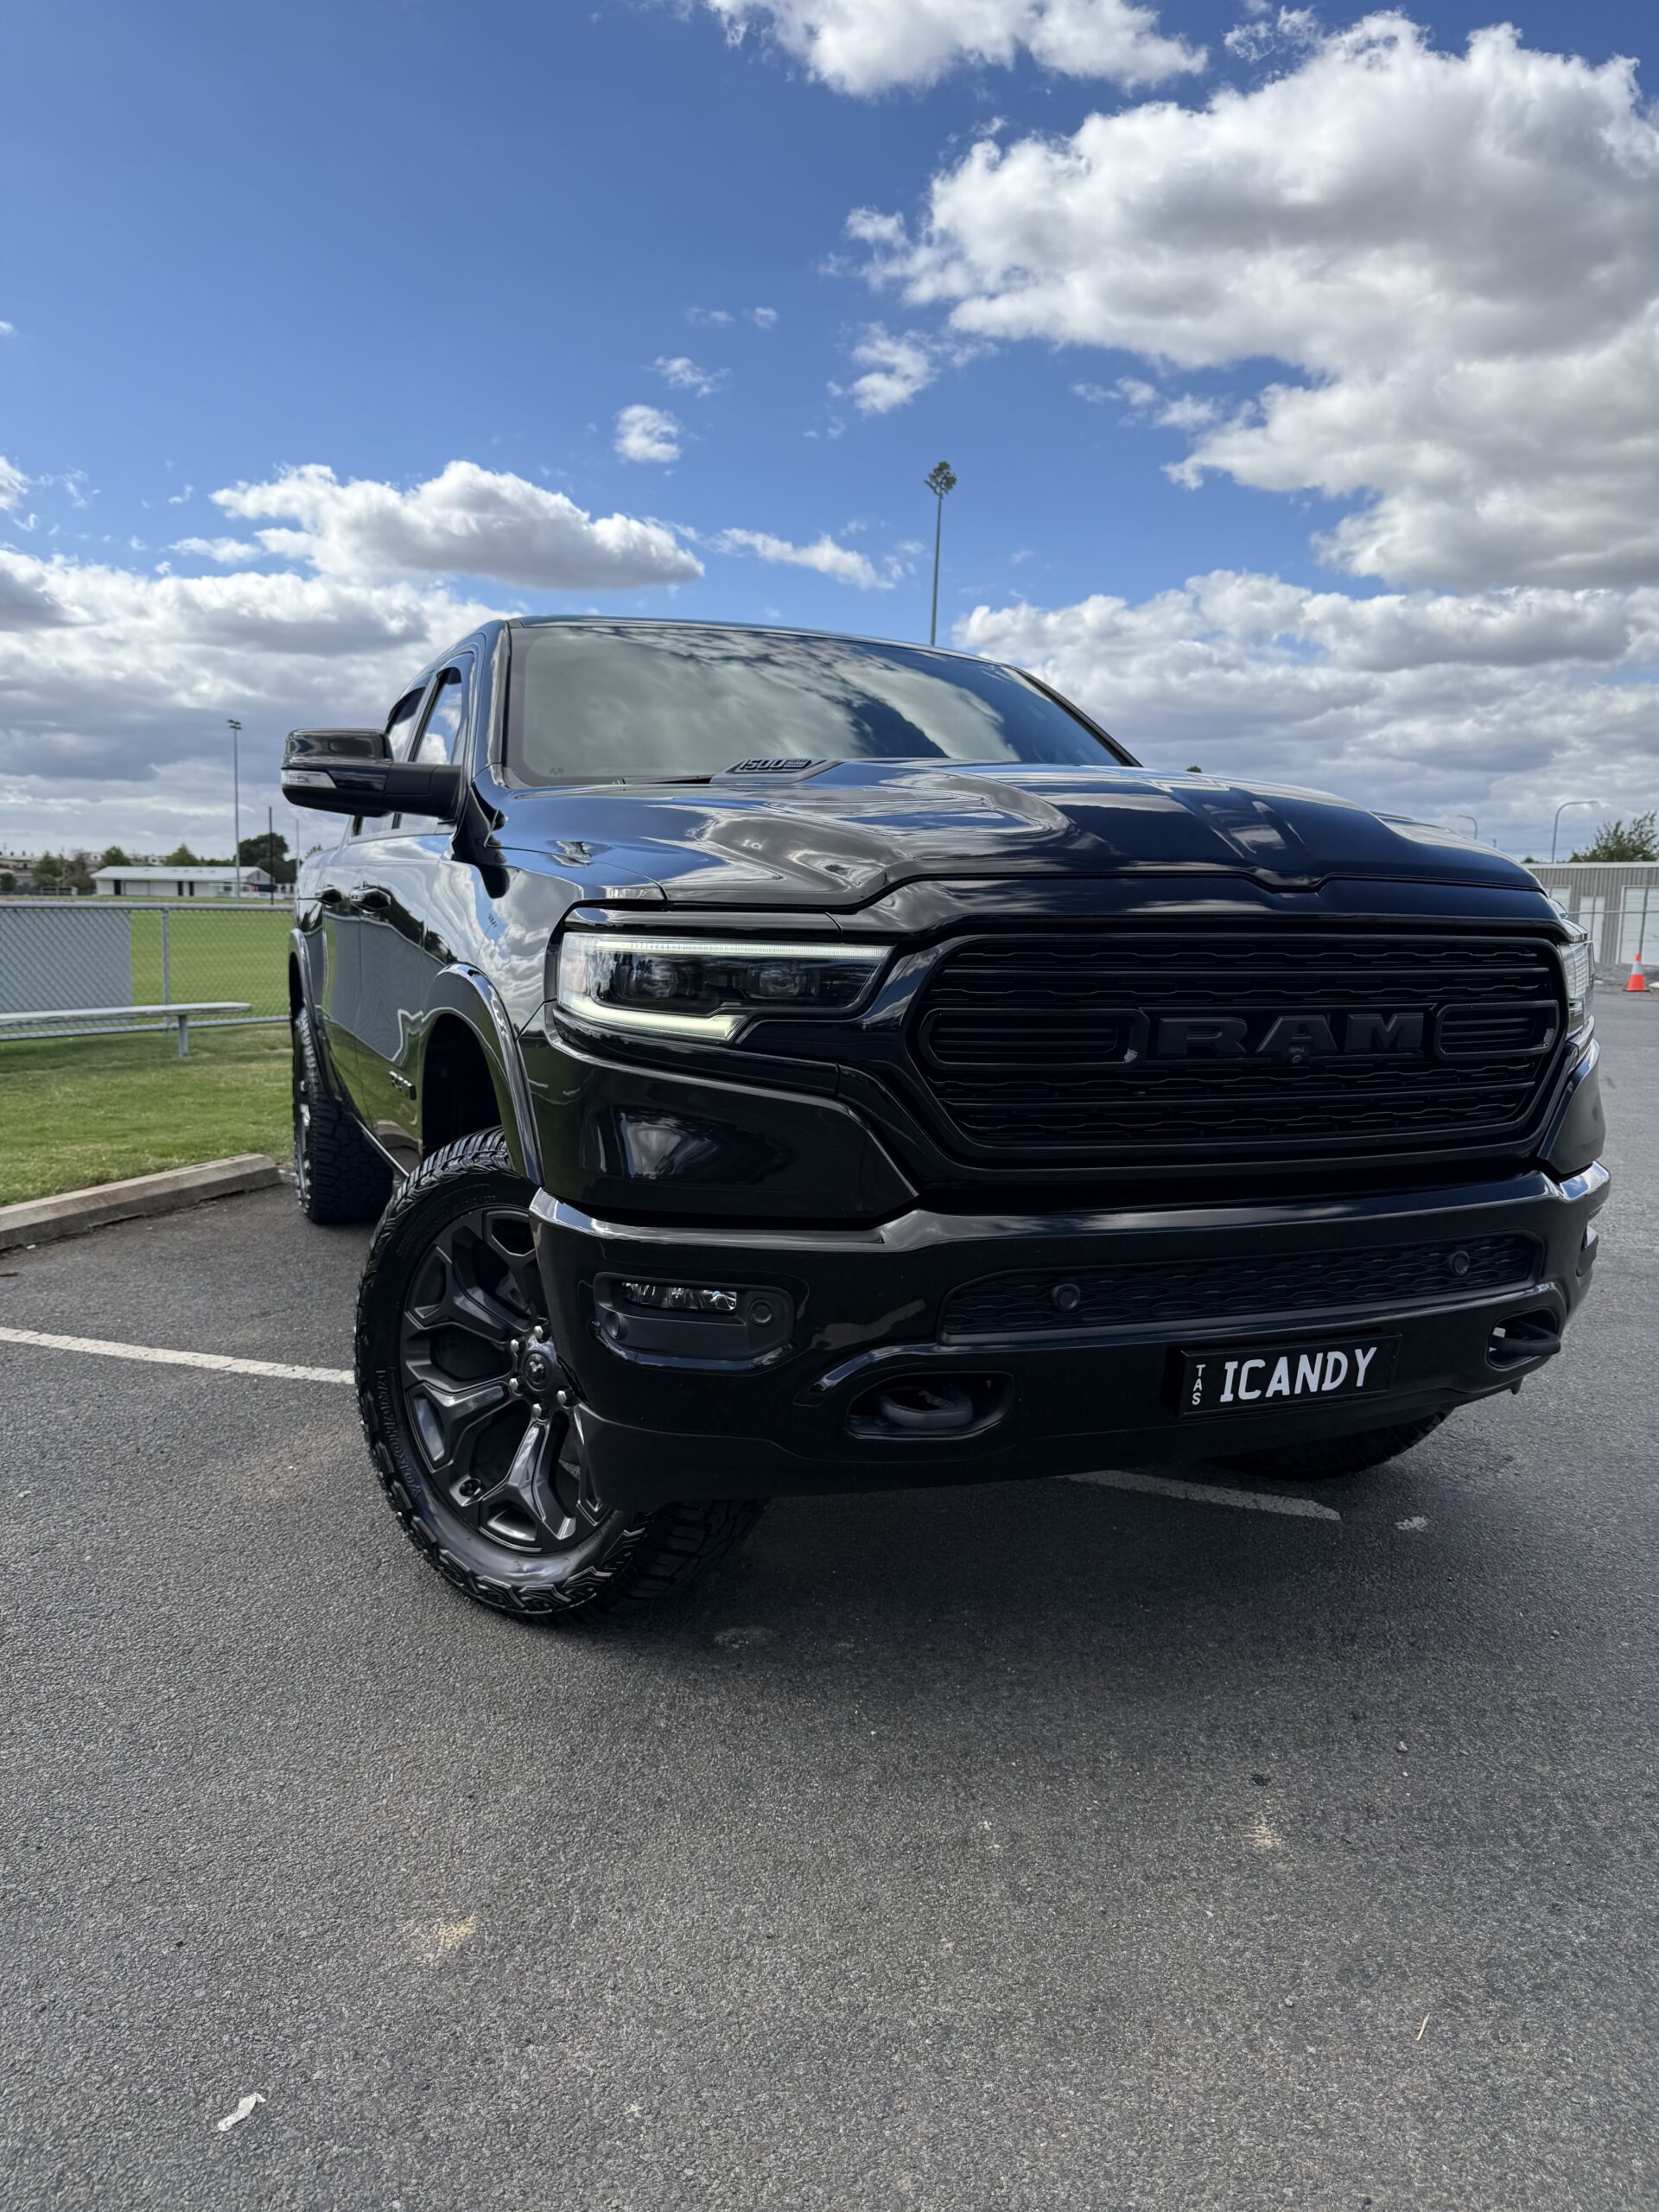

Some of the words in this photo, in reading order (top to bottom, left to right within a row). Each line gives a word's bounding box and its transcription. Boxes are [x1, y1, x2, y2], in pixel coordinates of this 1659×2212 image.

[740, 759, 786, 769] 1500
[1158, 1013, 1424, 1056] RAM
[1192, 1363, 1206, 1406] TAS
[1219, 1346, 1377, 1402] ICANDY
[374, 1369, 422, 1499] YOKOHAMA
